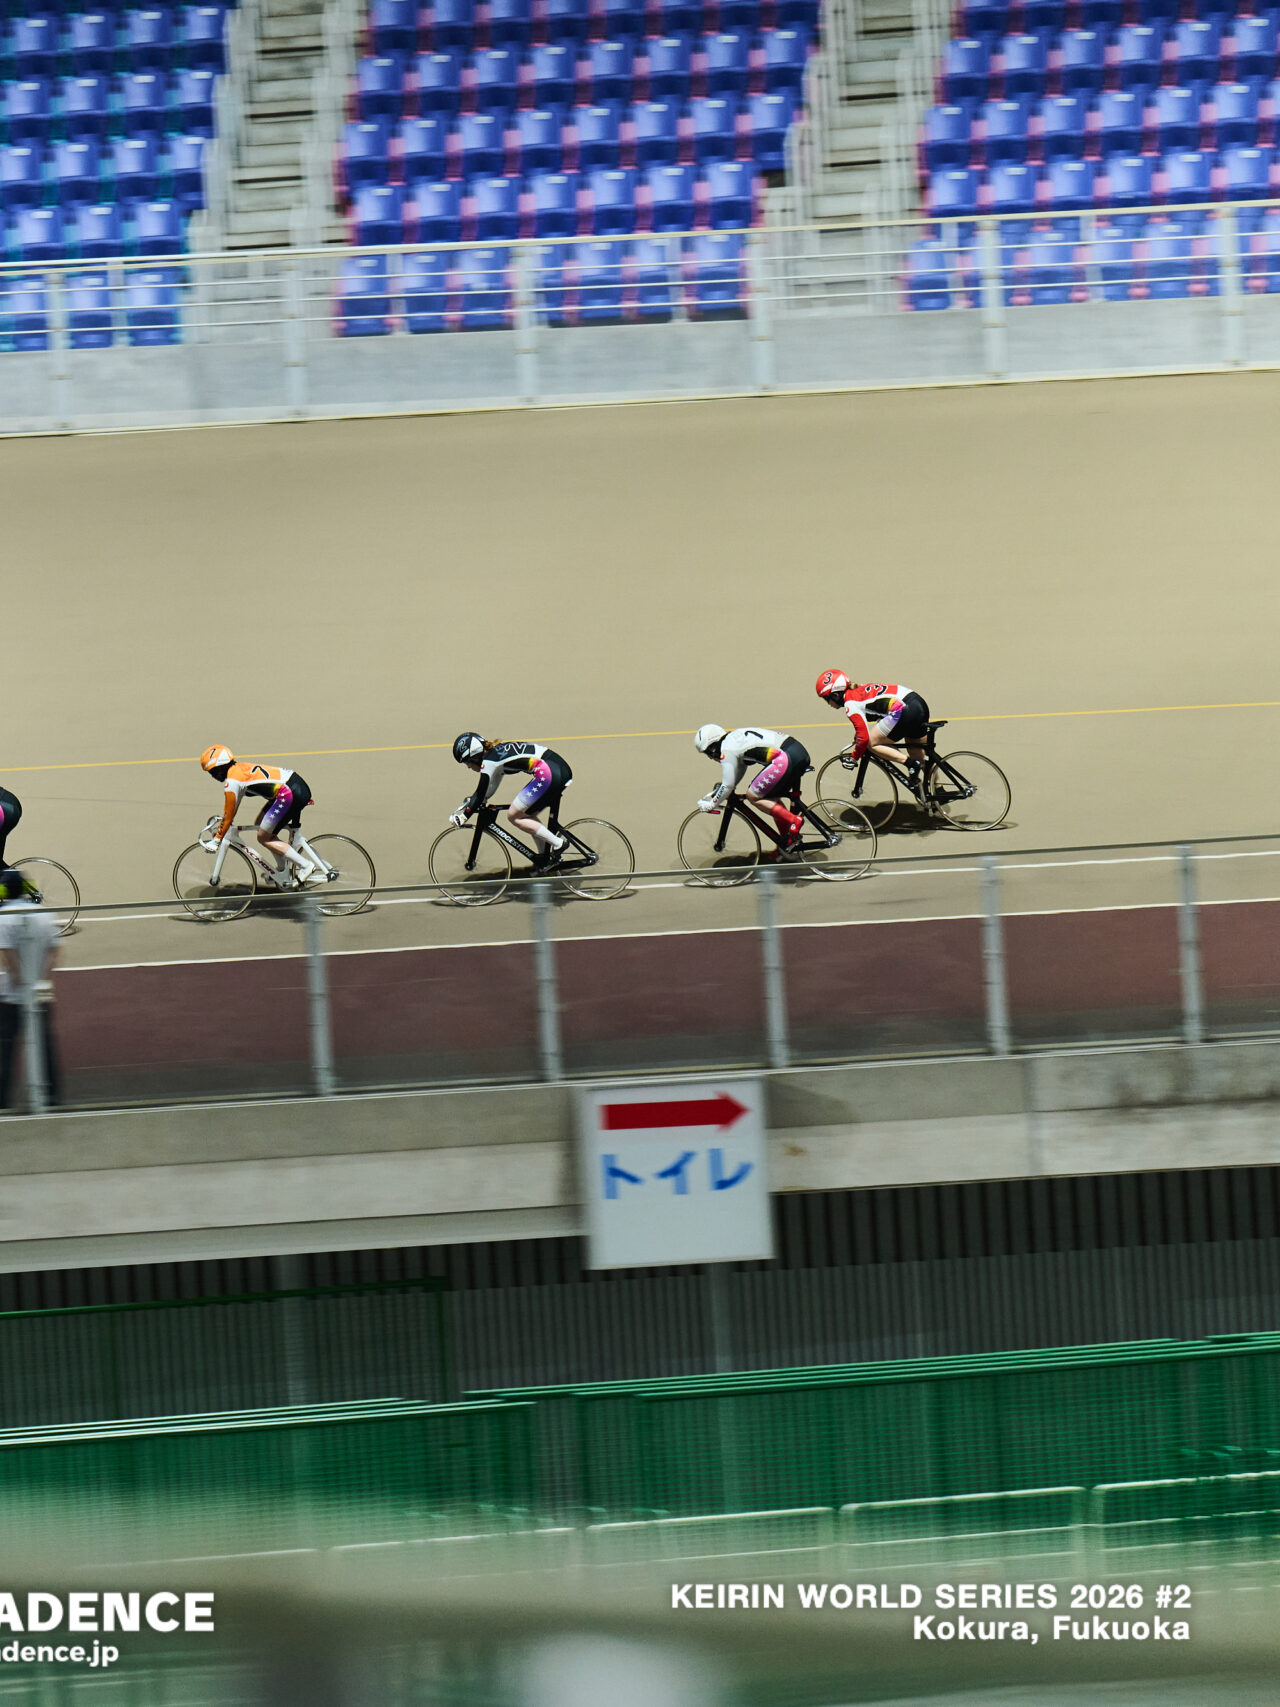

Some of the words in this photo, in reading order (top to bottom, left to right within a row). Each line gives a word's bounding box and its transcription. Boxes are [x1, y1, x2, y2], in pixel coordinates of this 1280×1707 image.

[823, 672, 833, 685] 3
[459, 740, 468, 753] 2
[504, 742, 527, 756] 2
[251, 765, 270, 780] 7
[488, 823, 534, 859] BRIDGESTONE
[601, 1147, 754, 1200] トイレ
